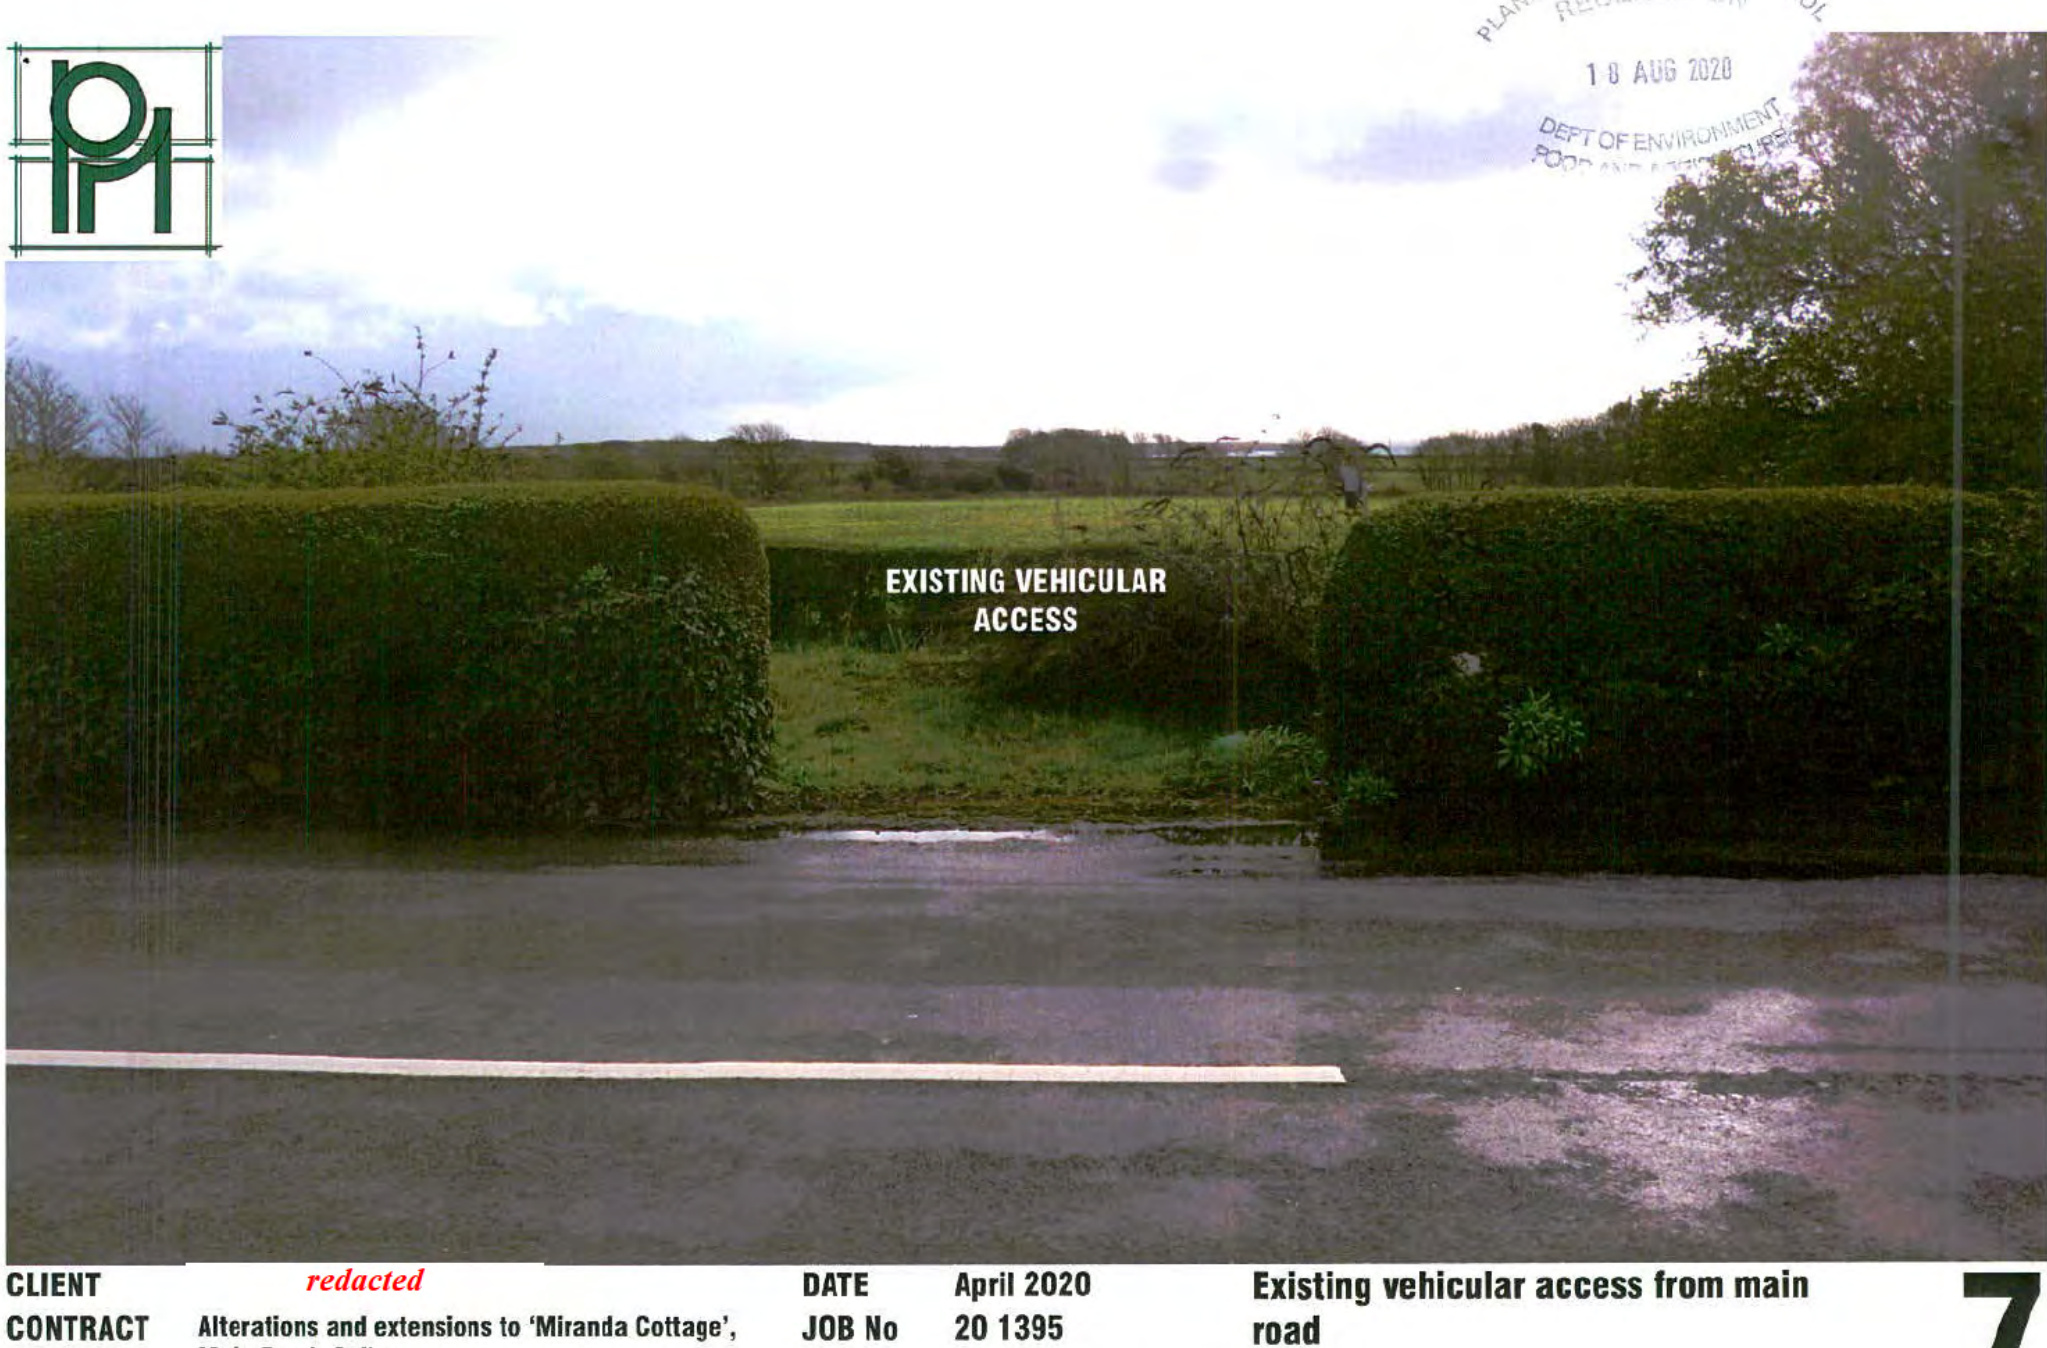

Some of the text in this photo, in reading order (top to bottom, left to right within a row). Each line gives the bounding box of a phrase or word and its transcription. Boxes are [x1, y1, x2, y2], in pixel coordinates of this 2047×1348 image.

[6, 1272, 102, 1297] CLIENT
[803, 1272, 869, 1297] DATE
[954, 1271, 1091, 1302] April 2020
[1253, 1270, 1809, 1306] Existing vehicular access from main
[1963, 1272, 2041, 1348] 7
[6, 1315, 150, 1341] CONTRACT
[198, 1315, 318, 1337] Alterations
[326, 1315, 367, 1337] and
[374, 1315, 492, 1337] extensions
[499, 1317, 521, 1337] to
[802, 1314, 898, 1341] JOB No
[954, 1314, 1063, 1341] 20 1395
[1253, 1314, 1320, 1346] road
